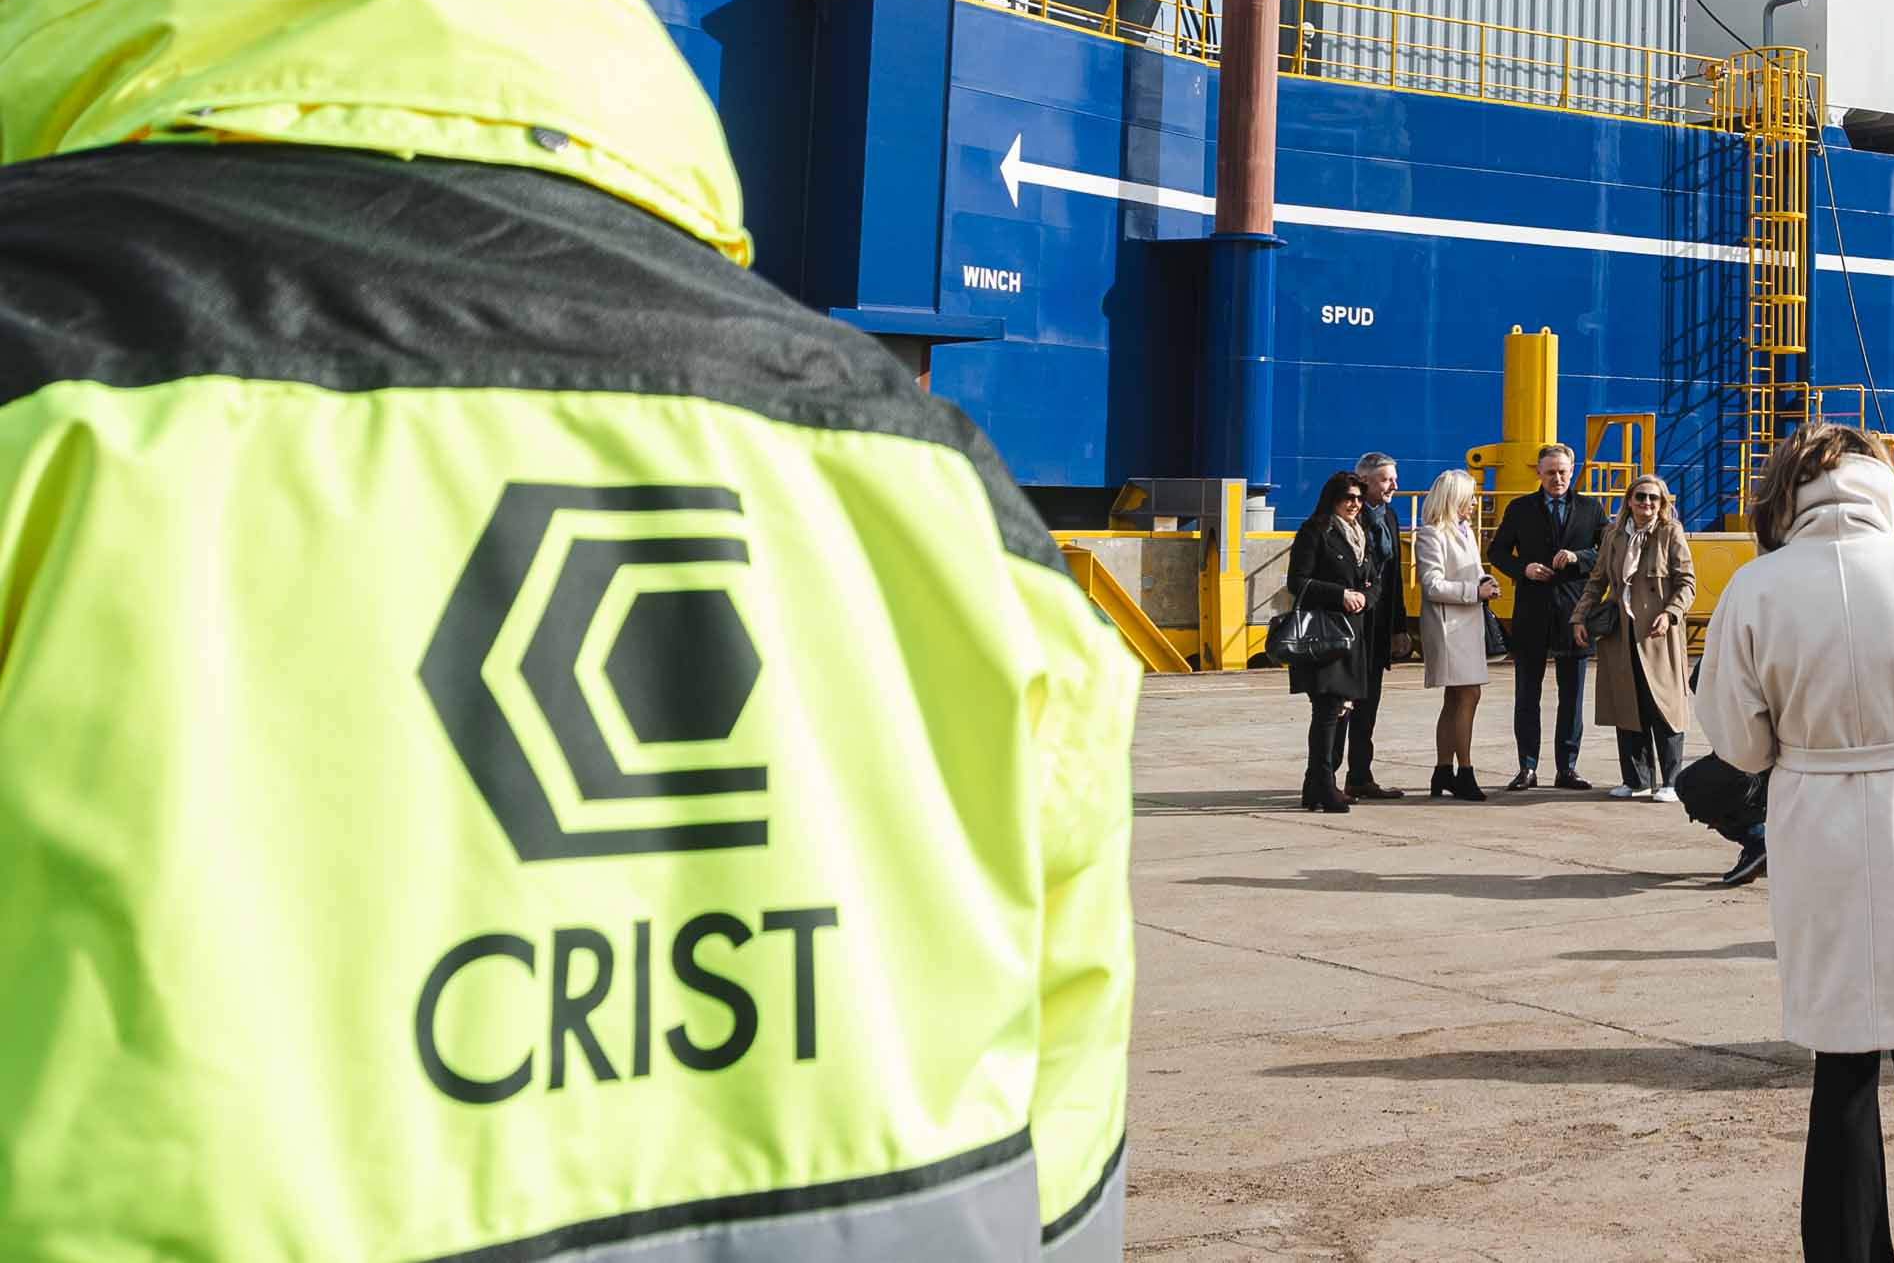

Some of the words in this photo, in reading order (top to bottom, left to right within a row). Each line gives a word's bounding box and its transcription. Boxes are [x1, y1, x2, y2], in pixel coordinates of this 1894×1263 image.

[963, 265, 1022, 293] WINCH
[1321, 305, 1374, 326] SPUD
[414, 906, 839, 1106] CRIST
